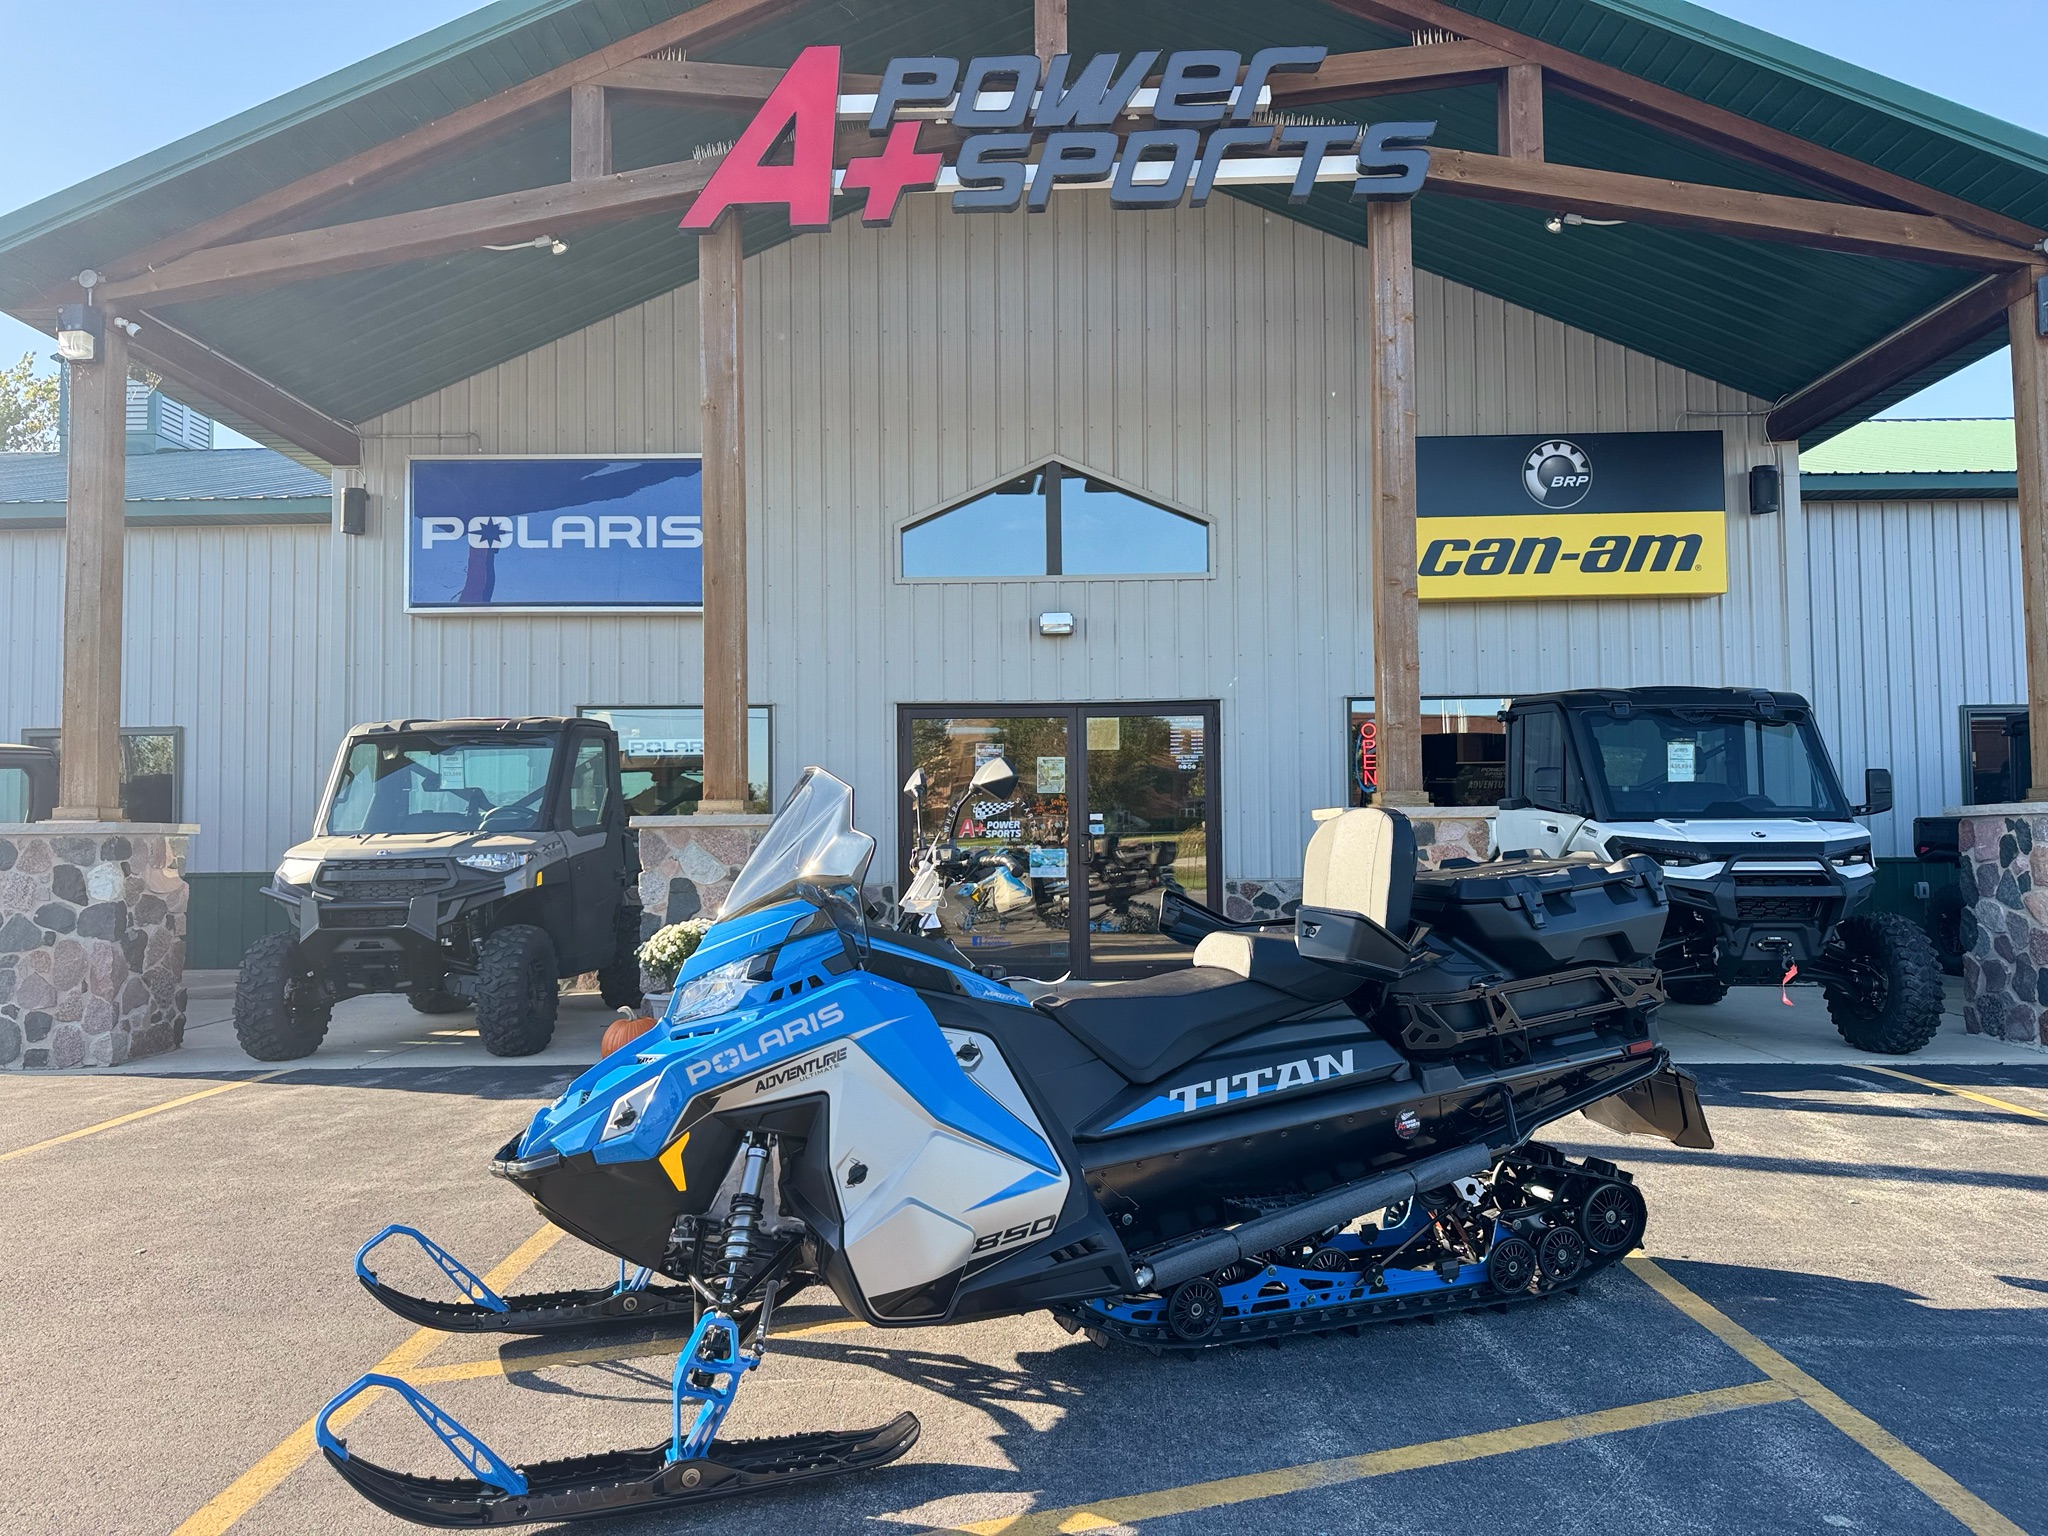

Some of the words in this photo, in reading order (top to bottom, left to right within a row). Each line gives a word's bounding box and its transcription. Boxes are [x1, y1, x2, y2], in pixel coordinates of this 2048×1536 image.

[1551, 475, 1589, 488] BRP
[422, 515, 703, 549] POLARIS
[1417, 533, 1703, 576] can-am
[630, 741, 703, 753] POLAR
[1361, 722, 1378, 785] OPEN
[1467, 780, 1504, 789] ADVENTU
[958, 818, 987, 838] A+
[986, 820, 1021, 830] POWER
[1015, 797, 1038, 832] STARTS
[542, 840, 560, 852] XP
[985, 829, 1021, 838] SPORTS
[685, 1002, 845, 1086] POLARIS
[755, 1047, 848, 1093] ADVENTURE
[799, 1063, 840, 1082] ULTIMATE
[1169, 1049, 1354, 1112] TITAN
[971, 1214, 1057, 1254] 850
